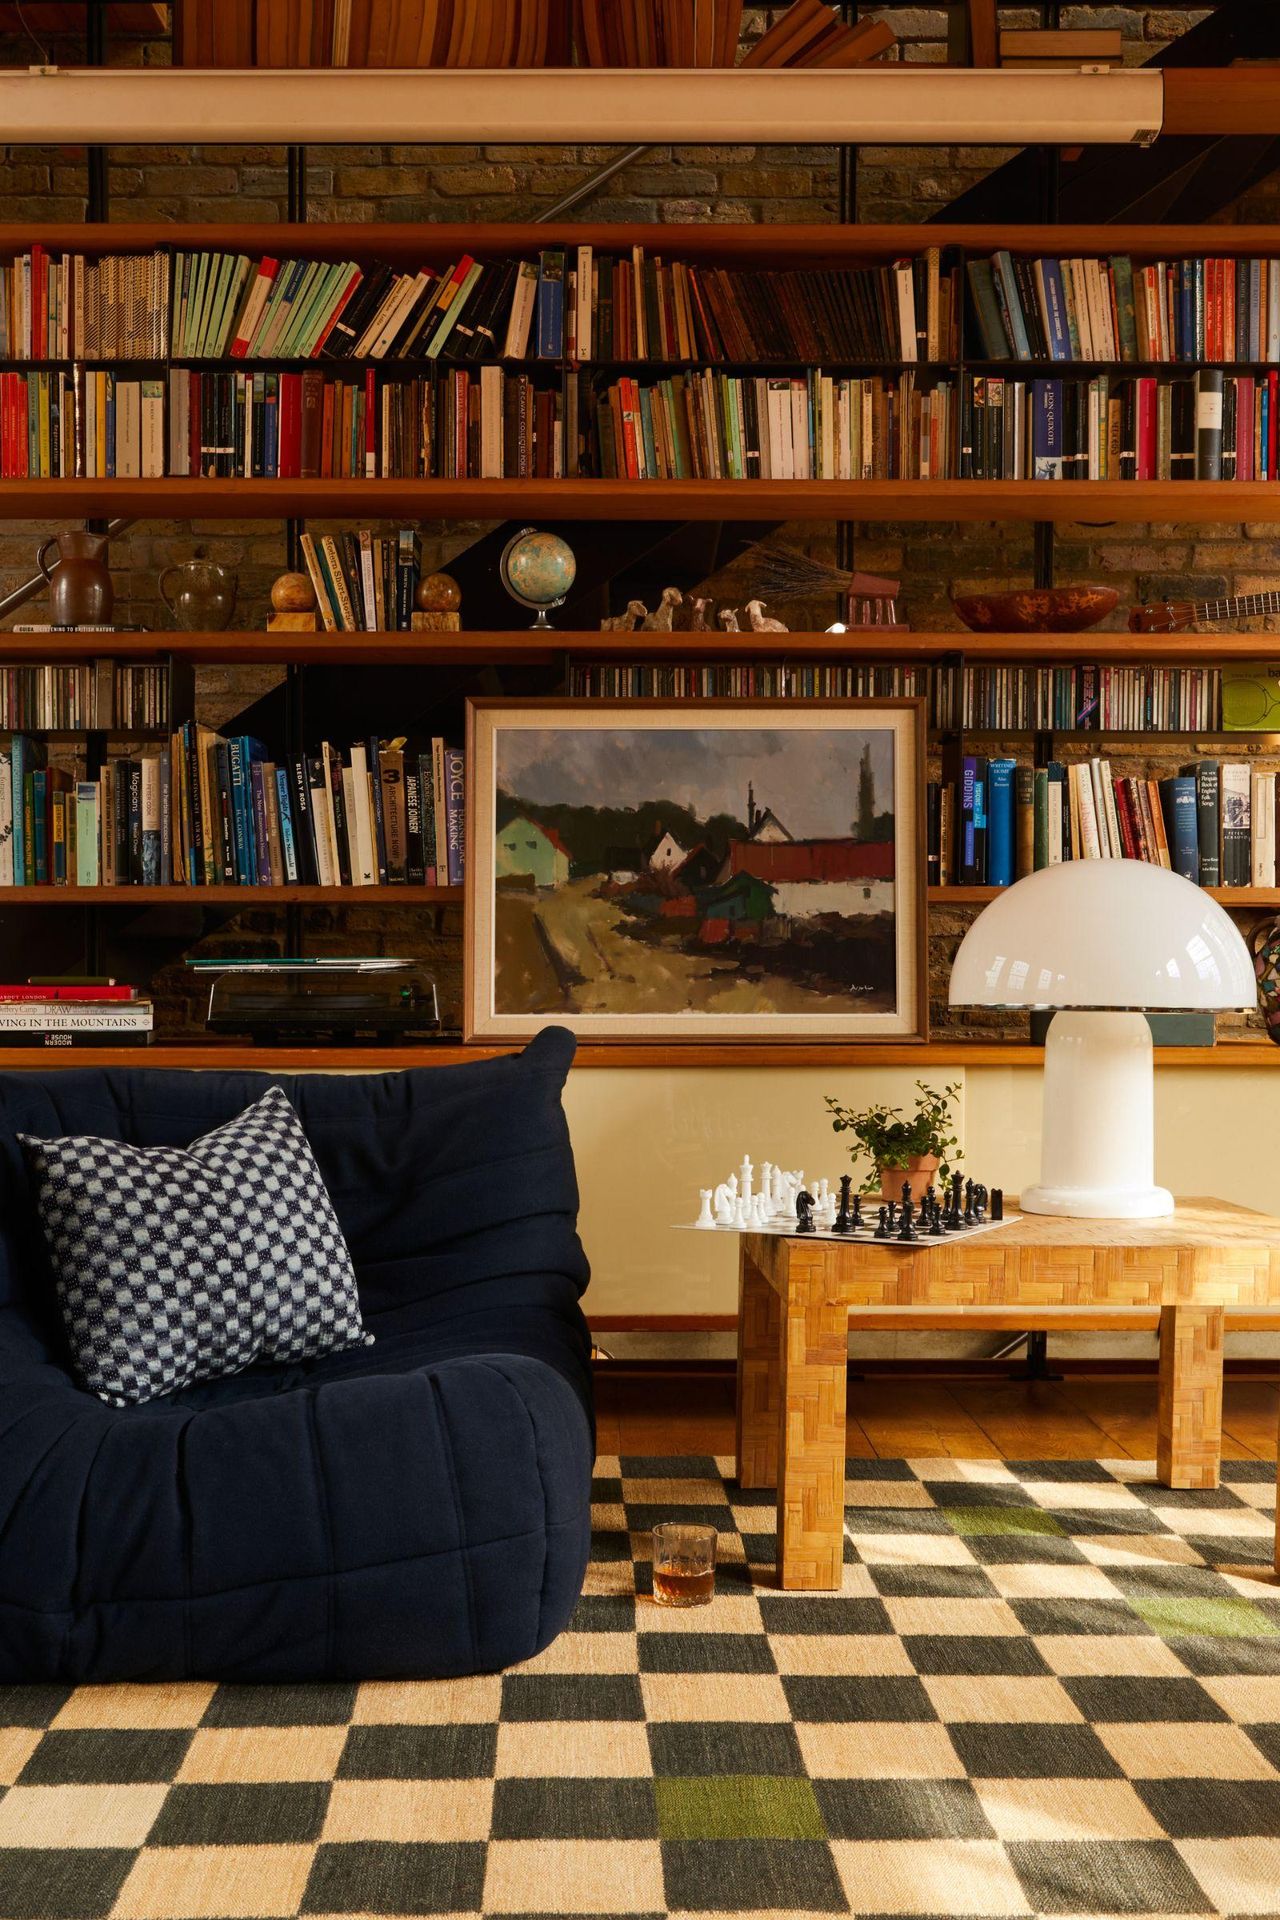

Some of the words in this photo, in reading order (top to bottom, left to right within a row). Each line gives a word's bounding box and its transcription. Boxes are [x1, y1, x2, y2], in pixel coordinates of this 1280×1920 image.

[230, 743, 241, 786] BUGATTI
[383, 769, 400, 784] 3
[450, 754, 464, 801] JOYCE
[130, 772, 140, 812] Magicians
[279, 774, 287, 794] Vesper
[406, 775, 418, 807] JAPANESE
[963, 769, 974, 808] GIDDINS
[389, 785, 398, 838] ARCHITECTURE
[409, 807, 419, 834] JOINERY
[449, 809, 458, 850] MAKING
[19, 1006, 37, 1015] Camp
[44, 1005, 72, 1014] DRAW
[30, 1018, 41, 1026] IN
[44, 1018, 68, 1026] THE
[71, 1018, 137, 1026] MOUNTAINS
